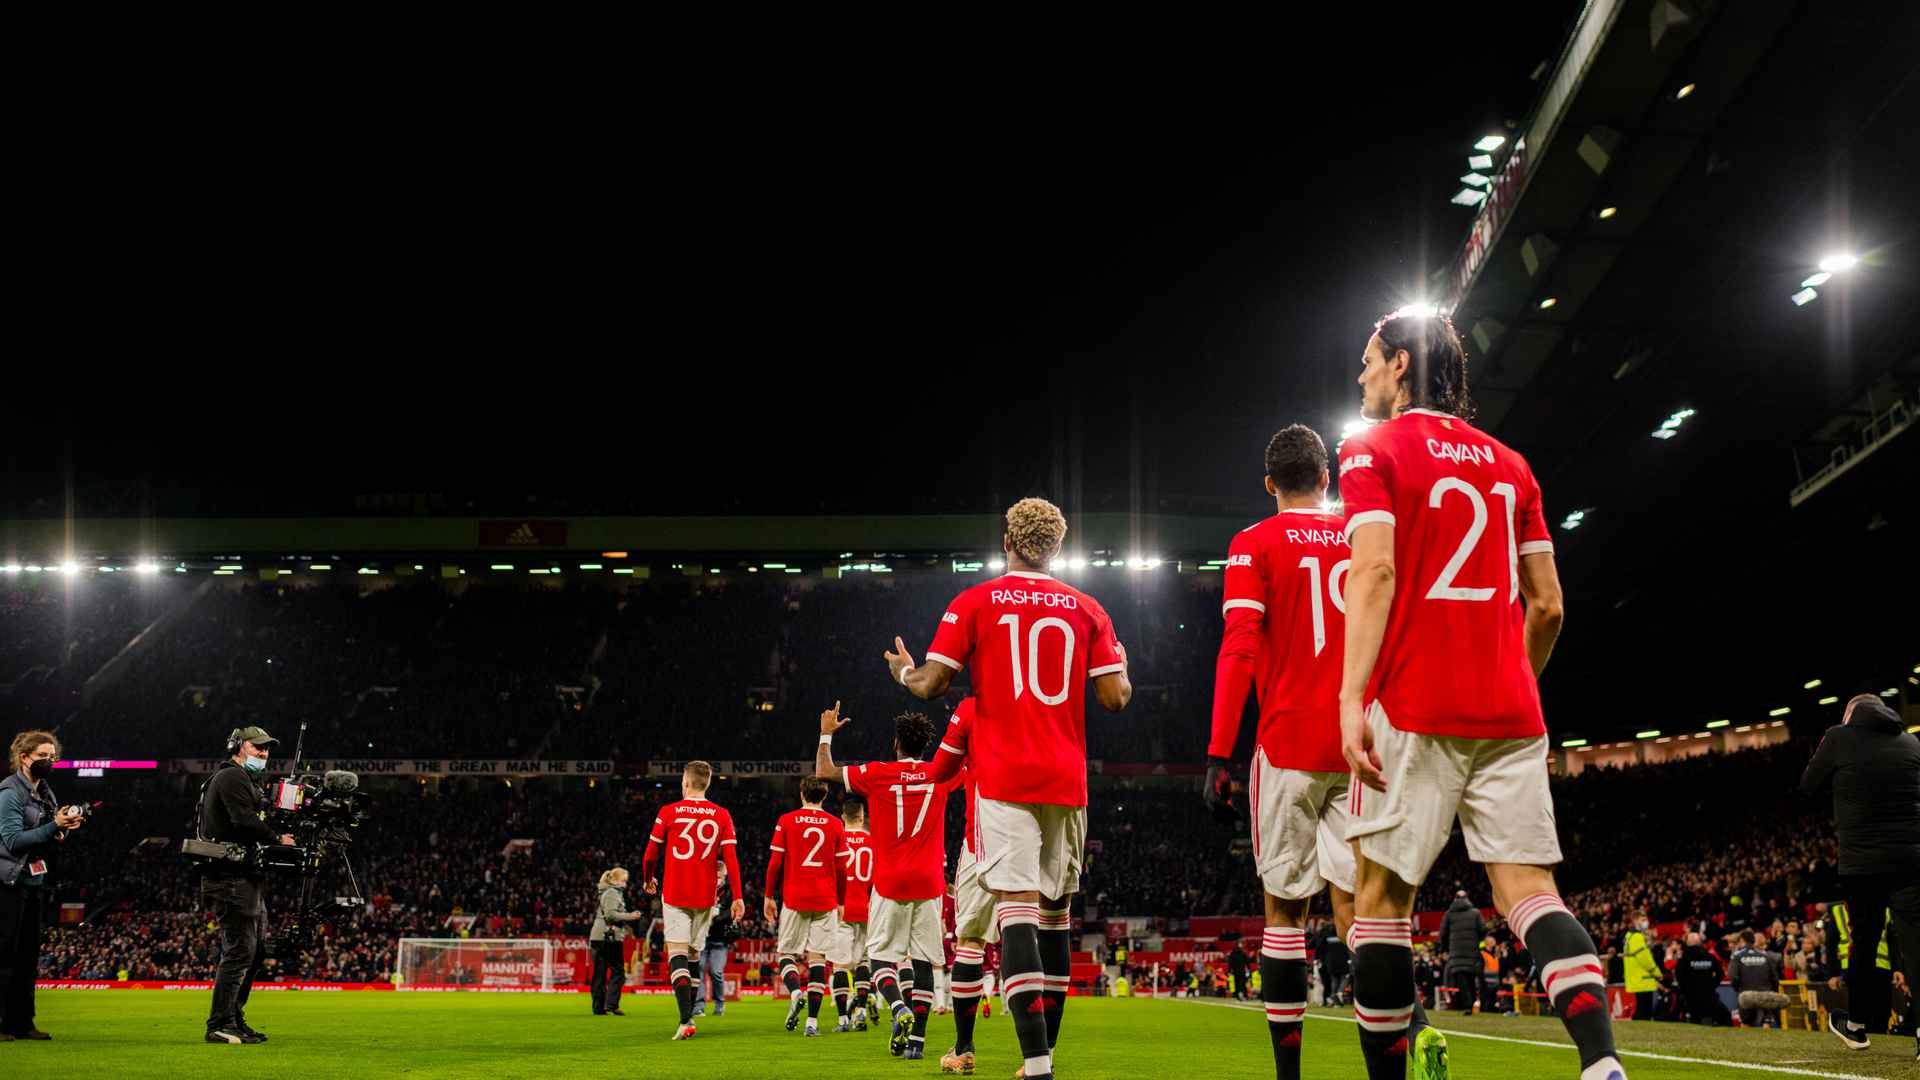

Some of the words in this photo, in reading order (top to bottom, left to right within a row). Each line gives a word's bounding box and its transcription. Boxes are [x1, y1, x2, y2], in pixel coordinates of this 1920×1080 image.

[1426, 438, 1495, 466] CAVANI
[1425, 477, 1519, 605] 21
[991, 589, 1077, 610] RASHFORD
[997, 614, 1075, 706] 10
[415, 761, 441, 772] THE
[449, 761, 496, 772] GREAT
[506, 761, 541, 772] MAN
[548, 761, 568, 772] HE
[576, 761, 610, 772] SAID
[732, 761, 800, 773] NOTHING
[901, 771, 926, 781] FRED
[889, 783, 935, 838] 17
[672, 818, 719, 860] 39
[801, 827, 825, 867] 2
[846, 837, 865, 845] ALOT
